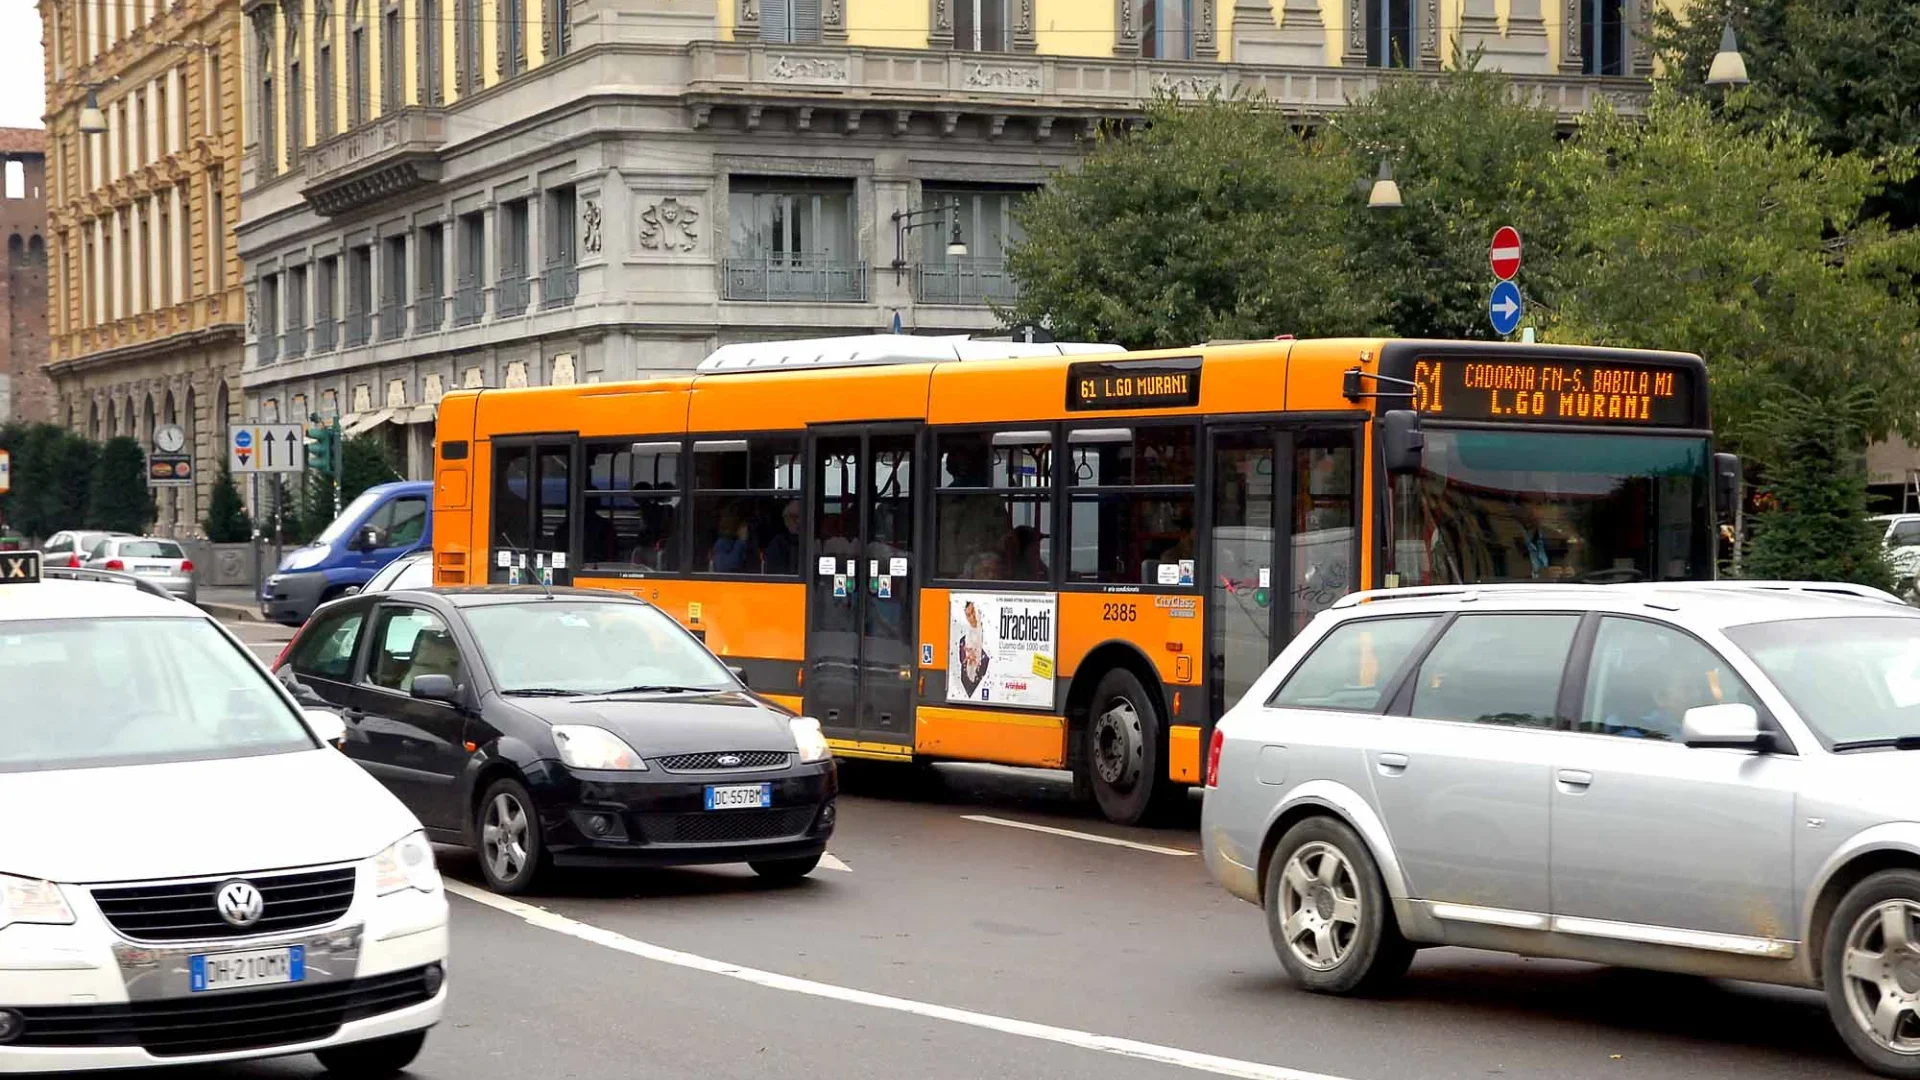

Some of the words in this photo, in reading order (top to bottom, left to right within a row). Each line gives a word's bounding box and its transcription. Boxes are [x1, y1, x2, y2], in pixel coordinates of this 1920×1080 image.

[1081, 380, 1096, 398] 61
[1105, 378, 1132, 397] L.GO
[1136, 375, 1187, 395] MURANI
[1413, 362, 1443, 411] 61
[1465, 364, 1535, 389] CADORNA
[1542, 367, 1585, 392] FN-S.
[1593, 369, 1648, 394] BABILA
[1655, 372, 1674, 396] M1
[1491, 390, 1544, 415] L.GO
[1560, 393, 1650, 419] MURANI
[1000, 607, 1050, 641] brachetti
[1103, 603, 1136, 621] 2385
[999, 642, 1016, 650] L'uomo
[1026, 643, 1038, 651] 1000
